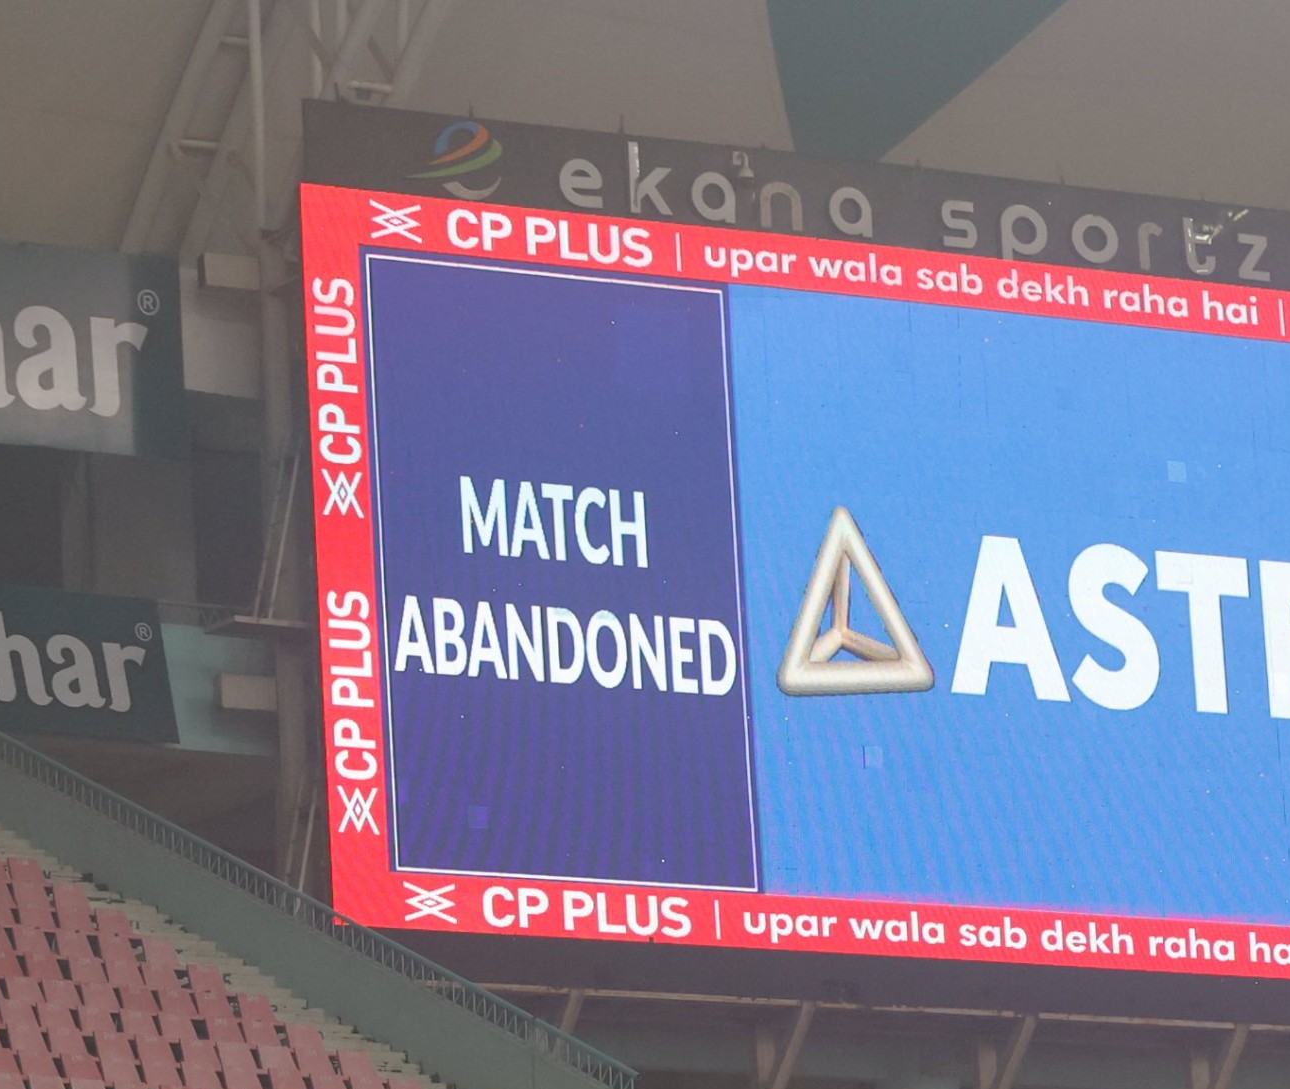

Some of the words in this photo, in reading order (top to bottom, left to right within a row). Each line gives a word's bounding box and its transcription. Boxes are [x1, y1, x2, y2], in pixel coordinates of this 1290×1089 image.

[559, 141, 874, 240] ekana
[941, 199, 1271, 283] sportz
[446, 209, 513, 252] CP
[526, 216, 654, 269] PLUS
[704, 243, 793, 278] upar
[809, 254, 903, 288] wala
[916, 263, 983, 298] sab
[997, 268, 1089, 308] dekh
[1103, 282, 1189, 320] raha
[1202, 294, 1259, 326] hai
[312, 277, 358, 394] PLUS
[317, 403, 363, 465] CP
[459, 475, 649, 569] MATCH
[326, 589, 375, 710] PLUS
[394, 594, 738, 697] ABANDONED
[333, 718, 379, 781] CP
[481, 884, 549, 930] CP
[563, 888, 693, 939] PLUS
[743, 908, 838, 945] upar
[848, 914, 945, 946] wala
[959, 914, 1027, 951] sab
[1041, 920, 1134, 958] dekh
[1148, 927, 1235, 964] raha
